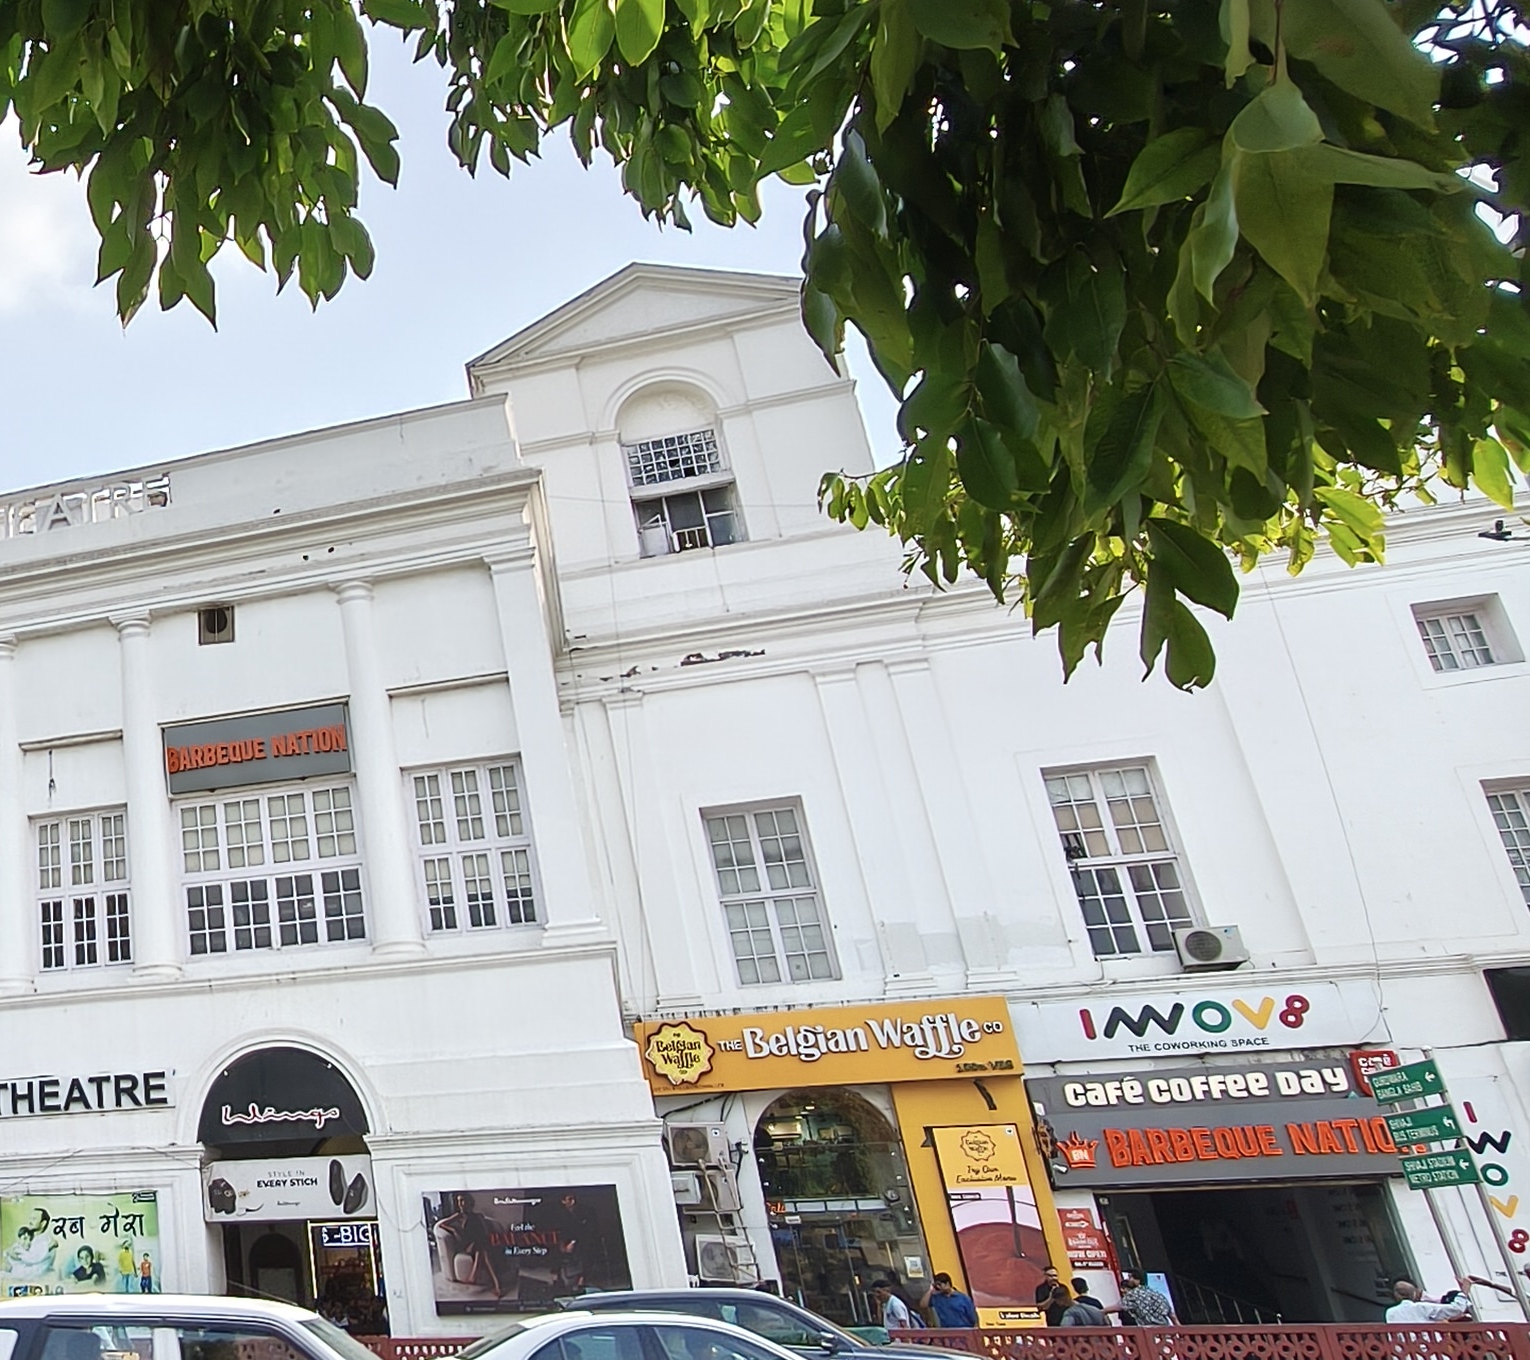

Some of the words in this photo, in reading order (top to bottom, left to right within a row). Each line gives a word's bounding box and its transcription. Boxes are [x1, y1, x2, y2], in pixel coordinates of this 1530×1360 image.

[166, 738, 267, 775] BARBEQUE
[271, 725, 348, 758] NATION
[717, 1039, 743, 1052] THE
[742, 1025, 869, 1062] Belgian
[865, 1013, 982, 1060] Waffle
[1128, 1044, 1151, 1053] THE
[1154, 1039, 1228, 1051] COWORKING
[1231, 1037, 1270, 1048] SPACE
[656, 1040, 701, 1054] Belgian
[661, 1052, 701, 1069] Waffle
[1275, 1067, 1349, 1096] Day
[1103, 1125, 1283, 1167] BARBEQUE
[1285, 1115, 1427, 1156] NATIO
[256, 1179, 288, 1188] EVERY
[289, 1177, 318, 1187] STICH
[267, 1170, 292, 1178] STYLE
